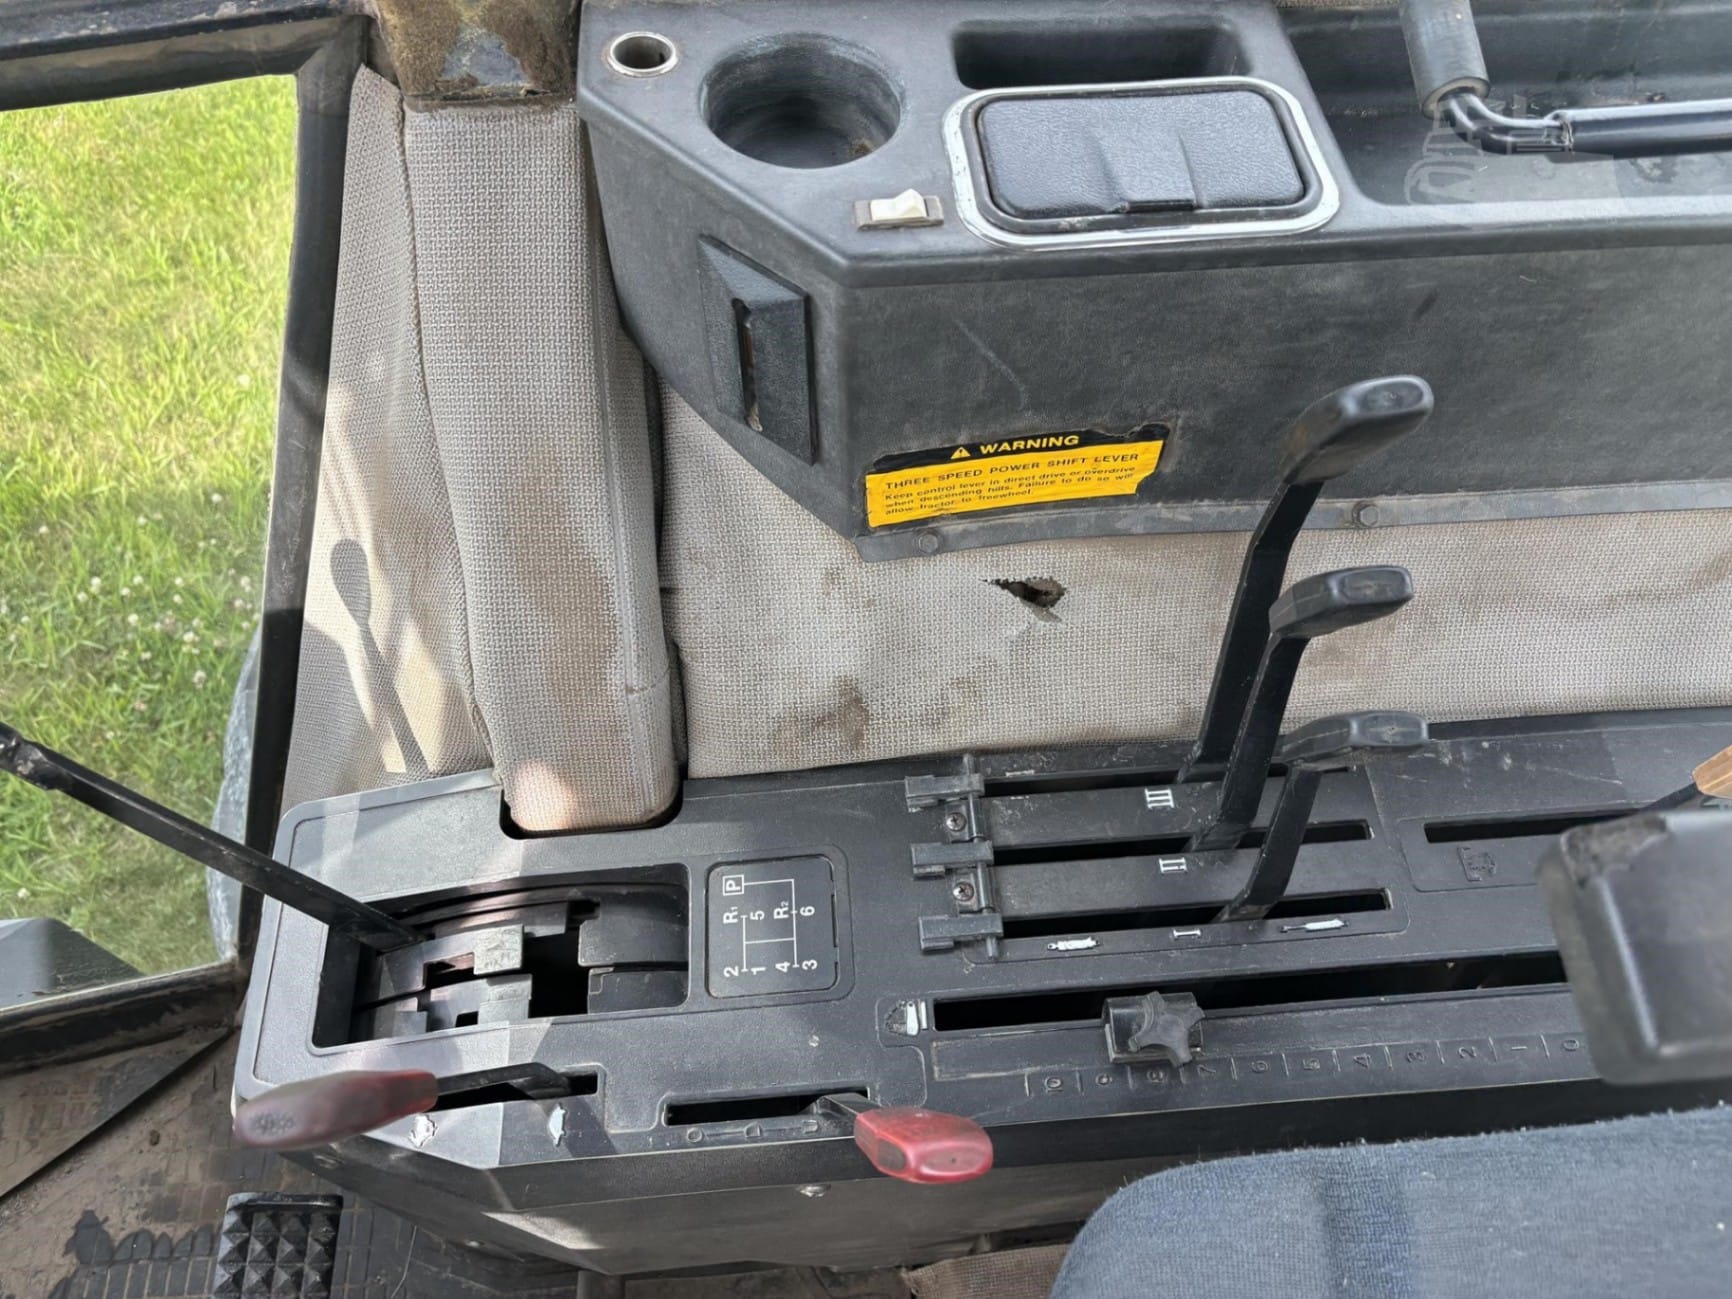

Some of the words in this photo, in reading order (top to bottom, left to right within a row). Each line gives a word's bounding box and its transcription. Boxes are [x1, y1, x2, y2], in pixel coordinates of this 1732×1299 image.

[980, 435, 1080, 454] WARNING
[885, 476, 931, 489] THREE
[938, 469, 983, 481] SPEED
[989, 462, 1040, 474] POWER
[1047, 457, 1087, 467] SHIFT
[1094, 453, 1139, 463] LEVER
[885, 491, 913, 501] Keep
[917, 484, 956, 496] control
[960, 481, 985, 490] lever
[1004, 474, 1036, 483] direct
[1039, 471, 1066, 480] drive
[1084, 466, 1136, 475] overdrive
[885, 498, 914, 508] when
[920, 488, 983, 503] descending
[988, 485, 1013, 493] hills.
[1018, 479, 1056, 488] Failure
[885, 506, 914, 515] allow
[920, 500, 955, 510] tractor
[726, 880, 741, 891] P
[750, 910, 765, 921] 5
[800, 906, 815, 916] 6
[775, 961, 791, 973] 4
[802, 959, 818, 970] 3
[724, 966, 739, 977] 2
[751, 966, 767, 975] 1
